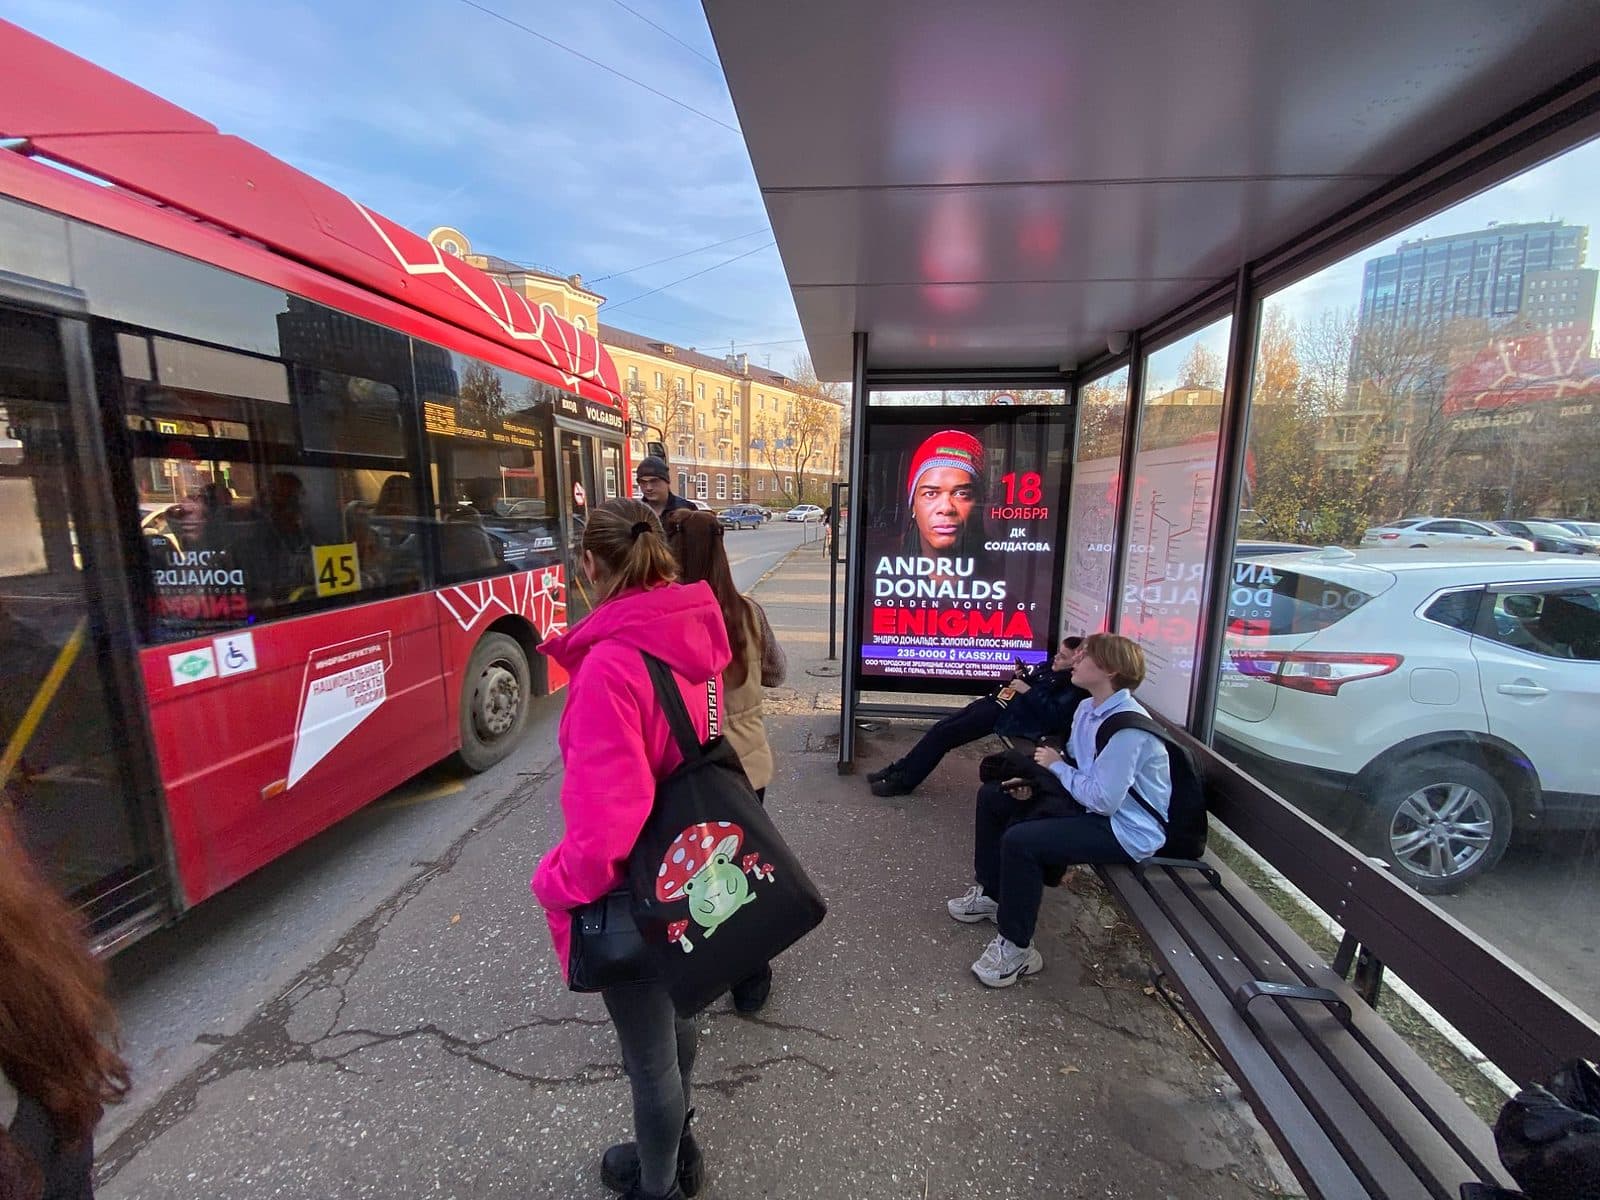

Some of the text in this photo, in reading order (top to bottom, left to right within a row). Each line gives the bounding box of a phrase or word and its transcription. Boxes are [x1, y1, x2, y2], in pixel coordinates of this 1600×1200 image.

[585, 404, 623, 428] VOLGABUS
[1001, 471, 1042, 505] 18
[991, 507, 1048, 520] НОЯБРЯ
[1009, 527, 1026, 538] ДК
[984, 541, 1050, 552] СОЛДАТОВА
[319, 555, 355, 588] 45
[875, 556, 974, 577] ANDRU
[875, 578, 1007, 600] DONALDS
[874, 599, 1036, 611] GOLDEN VOICE OF
[872, 608, 1034, 638] ENIGMA
[873, 635, 899, 645] ЭНДРЮ
[940, 636, 974, 648] ЗОЛОТОЙ
[975, 638, 1000, 648] ГОЛОС
[1001, 639, 1033, 649] ЭНИГМЫ
[897, 649, 1010, 661] 235-0000 KASSY.RU
